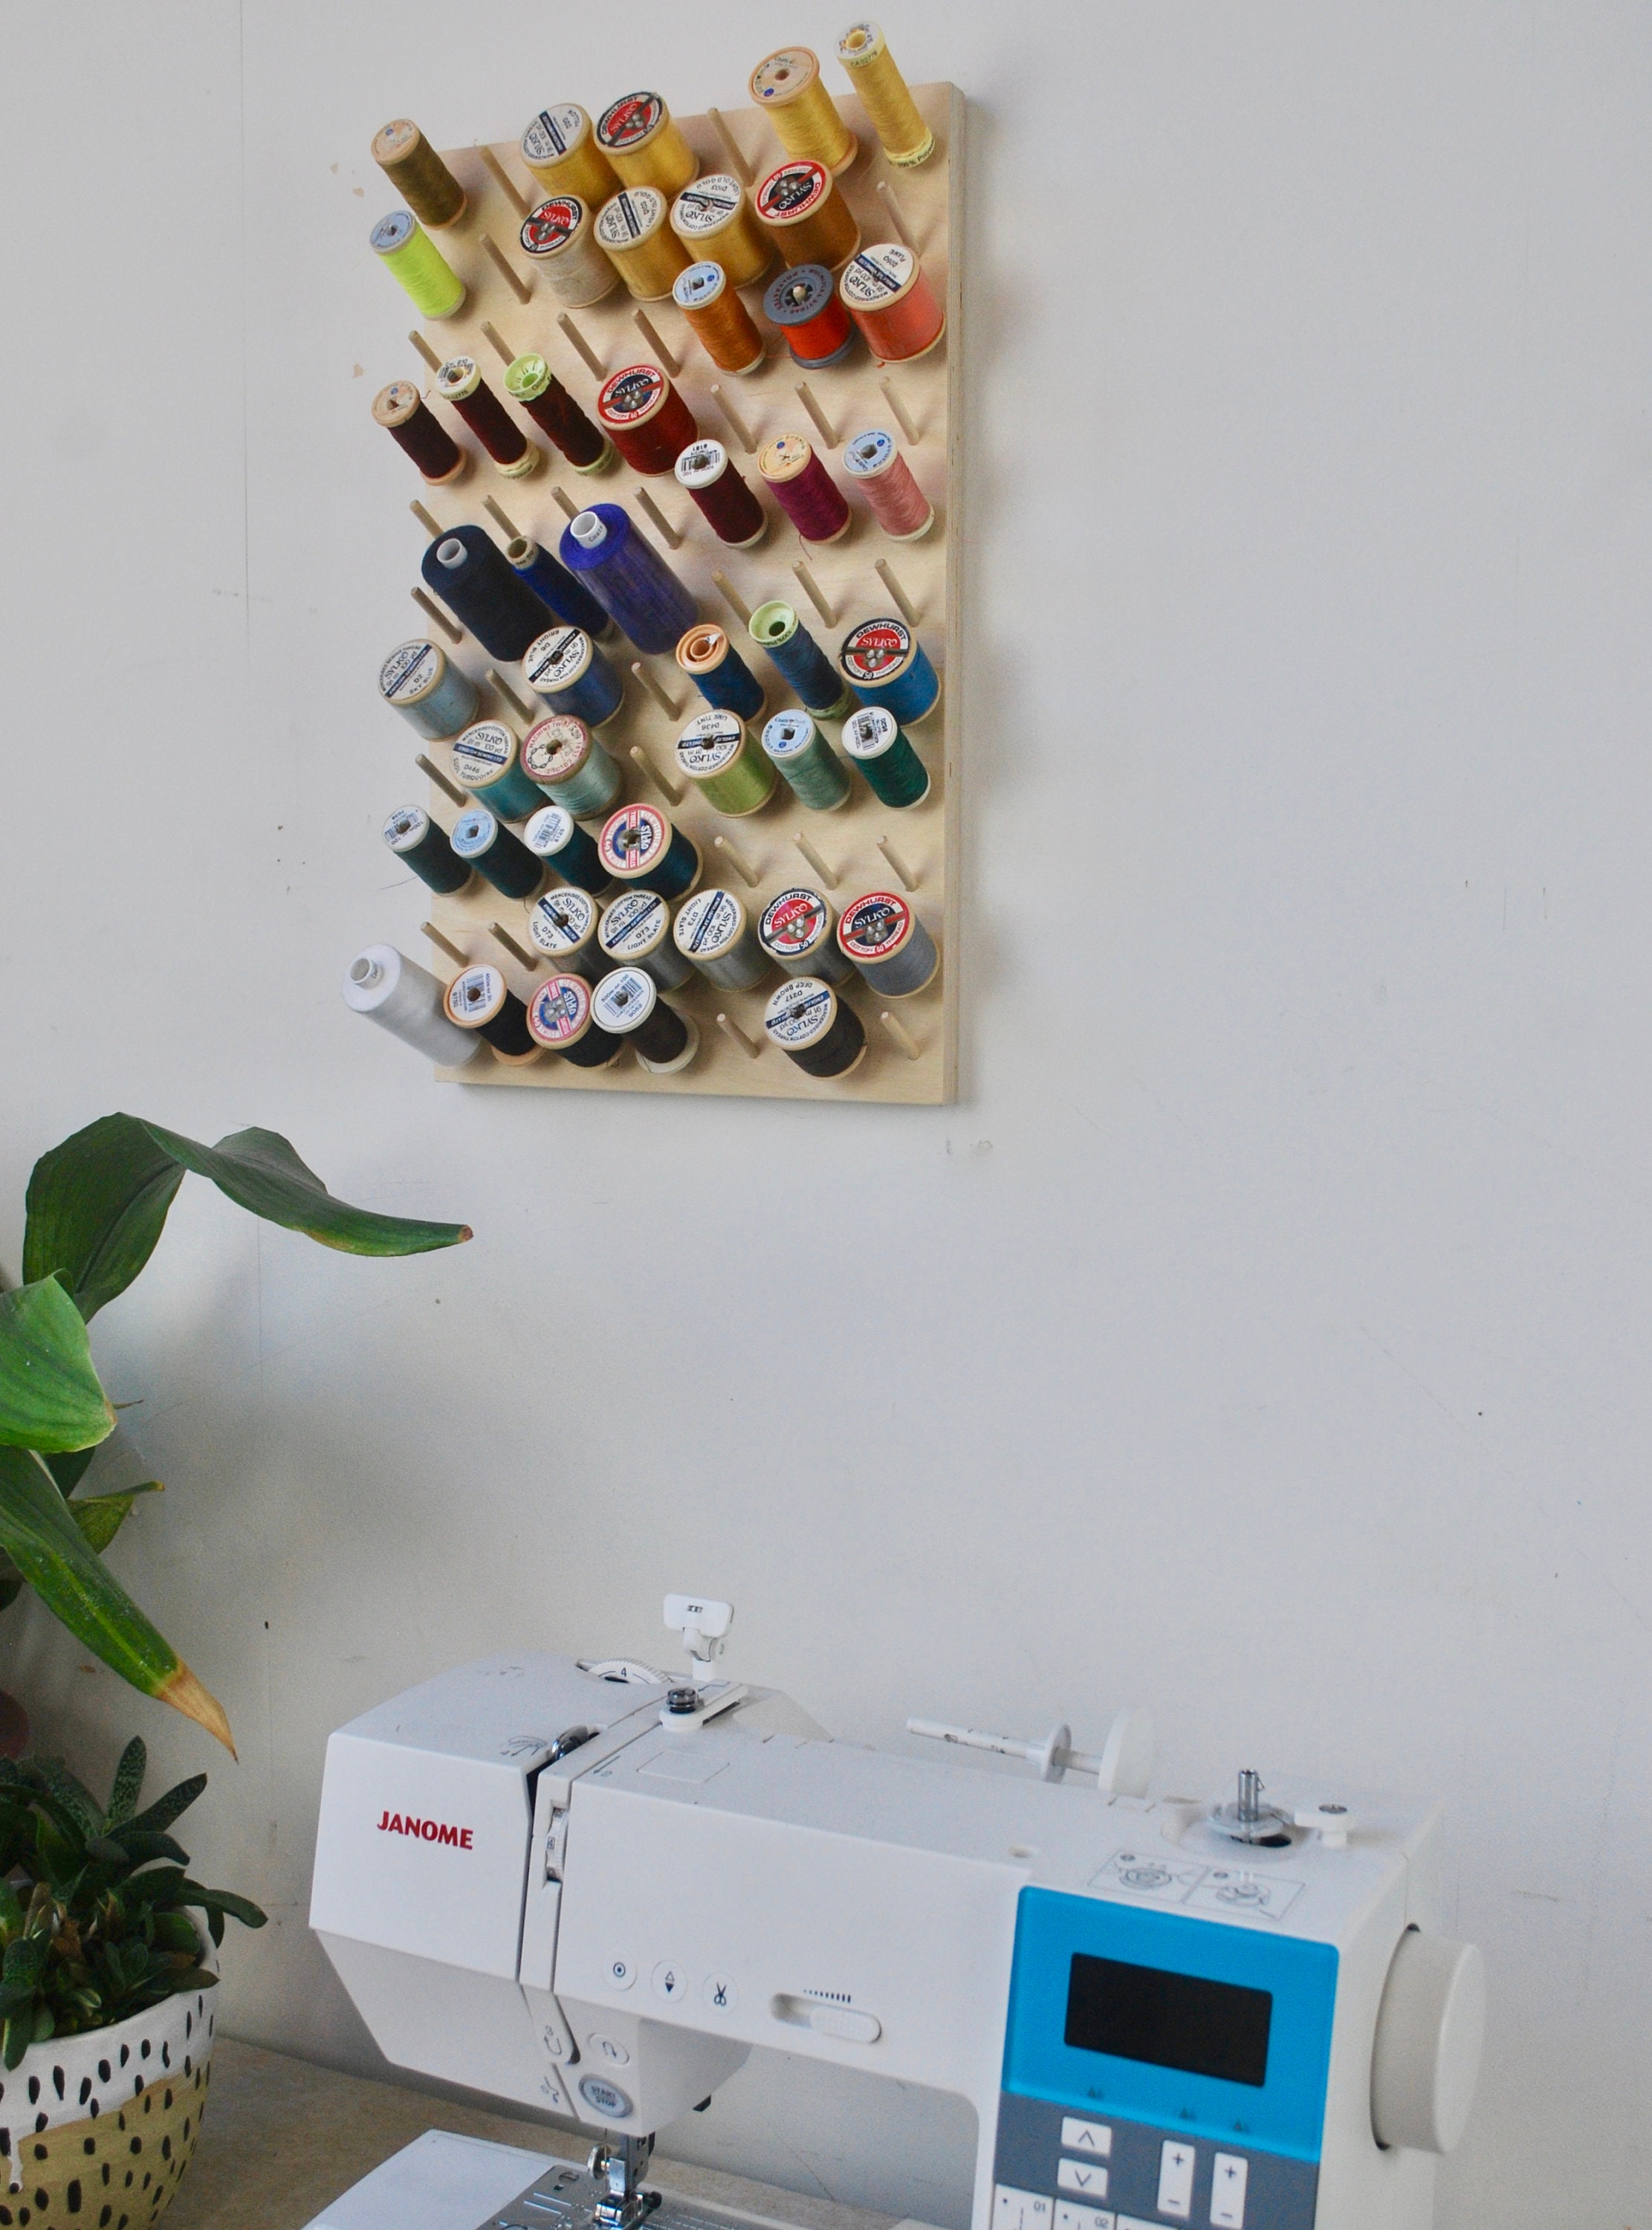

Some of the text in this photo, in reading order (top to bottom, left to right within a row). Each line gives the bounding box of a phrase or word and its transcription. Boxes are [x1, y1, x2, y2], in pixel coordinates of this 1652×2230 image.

[779, 182, 812, 210] SYLKO
[685, 211, 715, 222] SYLKO
[849, 276, 875, 297] SYLKO
[607, 369, 655, 392] DEWHURST
[615, 379, 649, 396] SYLKO
[856, 623, 906, 640] DEWHURST
[861, 638, 898, 647] SYLKO
[528, 630, 560, 662] BRIGHT BLUE
[384, 651, 408, 678] SYLKO
[554, 651, 580, 676] SYLKO
[409, 667, 433, 695] SKY BLUE
[413, 674, 422, 683] D2
[475, 732, 502, 745] SYLKO
[690, 753, 721, 763] SYLKO
[640, 825, 650, 850] SYLKO
[563, 897, 585, 921] SYLKO
[610, 899, 638, 927] SYLKO
[628, 909, 638, 919] 100
[678, 899, 702, 936] LIGHT SLATE
[765, 893, 812, 925] DEWHURST
[774, 903, 808, 928] SYLKO
[845, 897, 896, 924] DEWHURST
[855, 908, 890, 928] SYLKO
[533, 921, 557, 948] LIGHT SLATE
[542, 926, 554, 939] D73
[627, 919, 661, 950] LIGHT SLATE
[712, 912, 732, 943] SYLKO
[849, 942, 873, 952] COTTON
[886, 922, 903, 945] THREAD
[621, 974, 629, 984] 100
[564, 991, 577, 1015] SYLKO
[772, 983, 794, 1005] BROWN
[785, 990, 803, 1002] D217
[787, 1015, 818, 1036] SYLKO
[790, 1032, 810, 1041] COTTON
[621, 1667, 627, 1678] 4
[377, 1811, 473, 1850] JANOME
[1033, 2200, 1046, 2212] 01
[1094, 2216, 1109, 2229] 02
